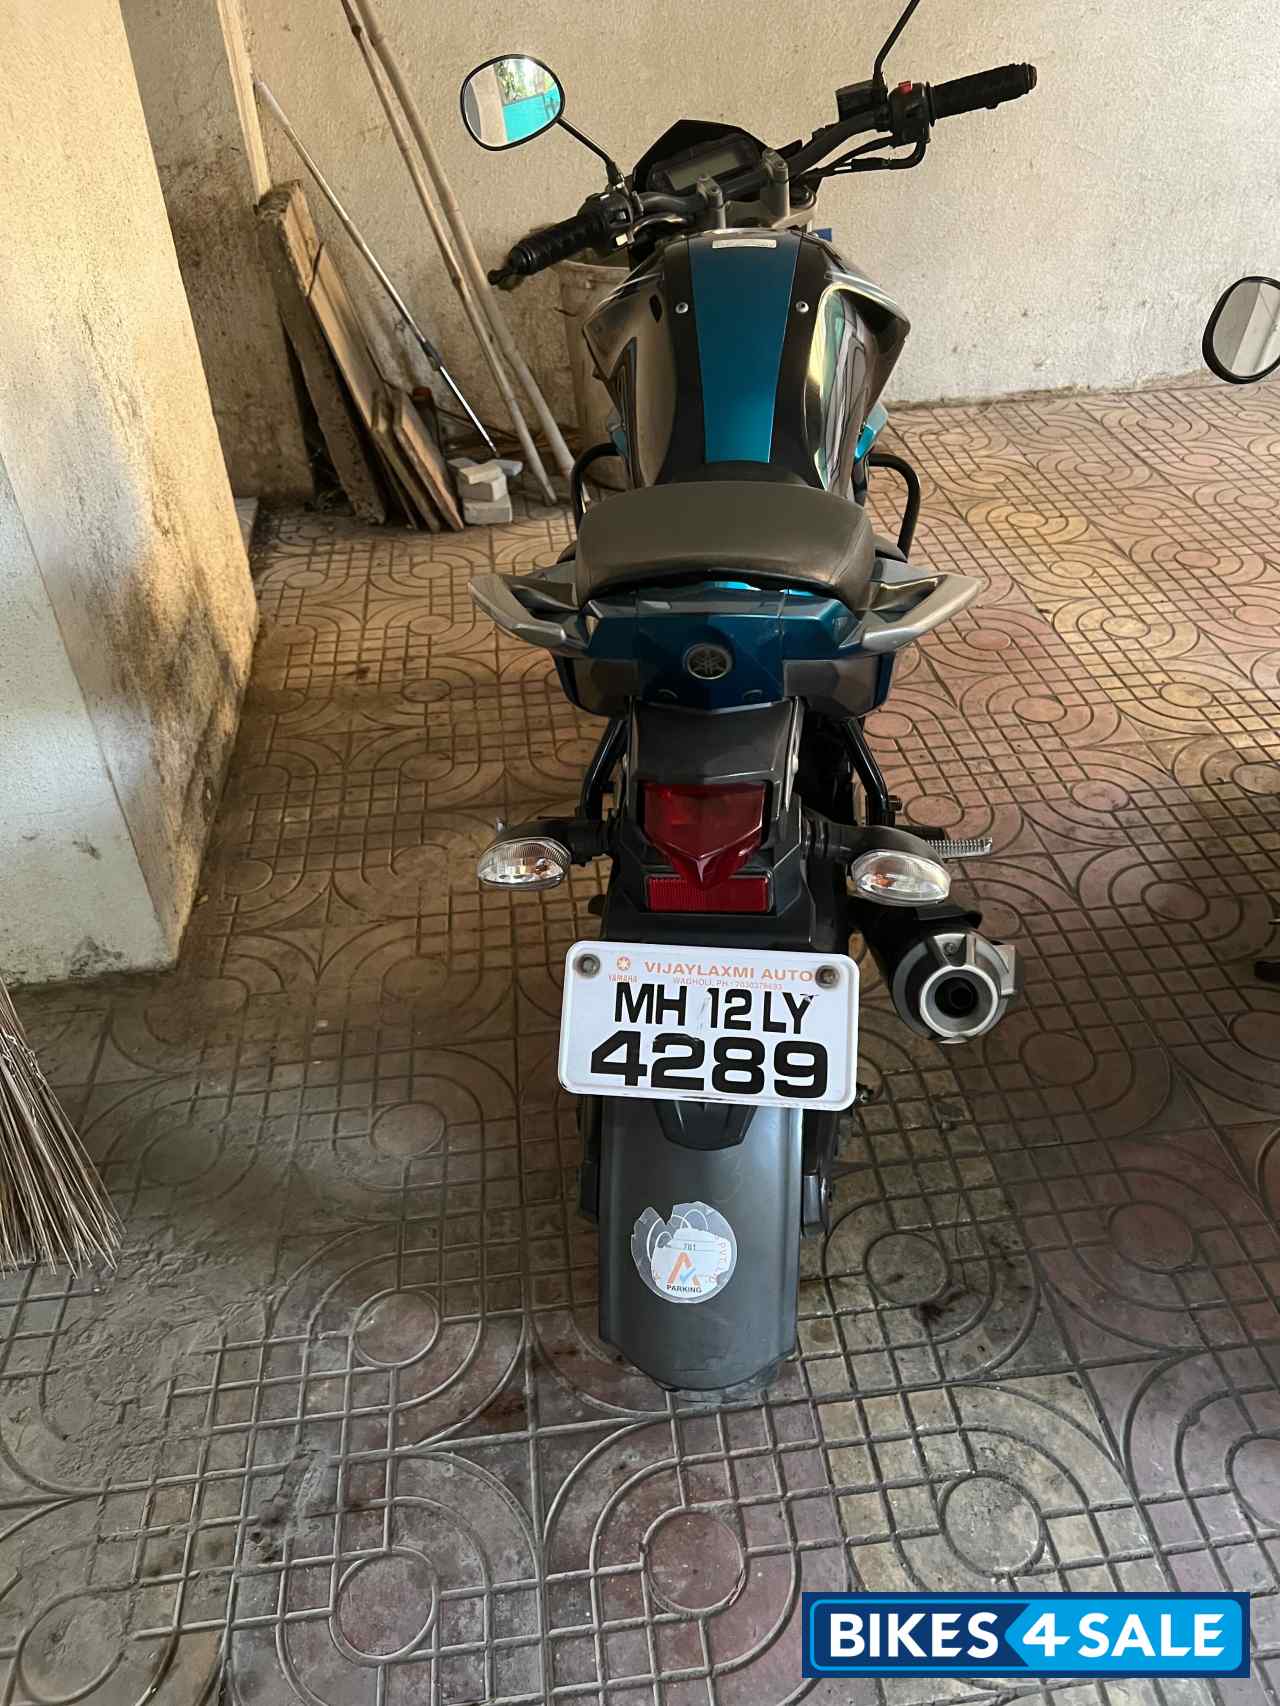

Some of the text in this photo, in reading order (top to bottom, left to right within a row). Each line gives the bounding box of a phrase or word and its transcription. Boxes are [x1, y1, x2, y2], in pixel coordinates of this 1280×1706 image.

[644, 960, 755, 979] VIJAYLAXMI
[614, 982, 815, 1035] MH 12 LY
[590, 1030, 829, 1099] 4289
[666, 1284, 702, 1293] PARKING
